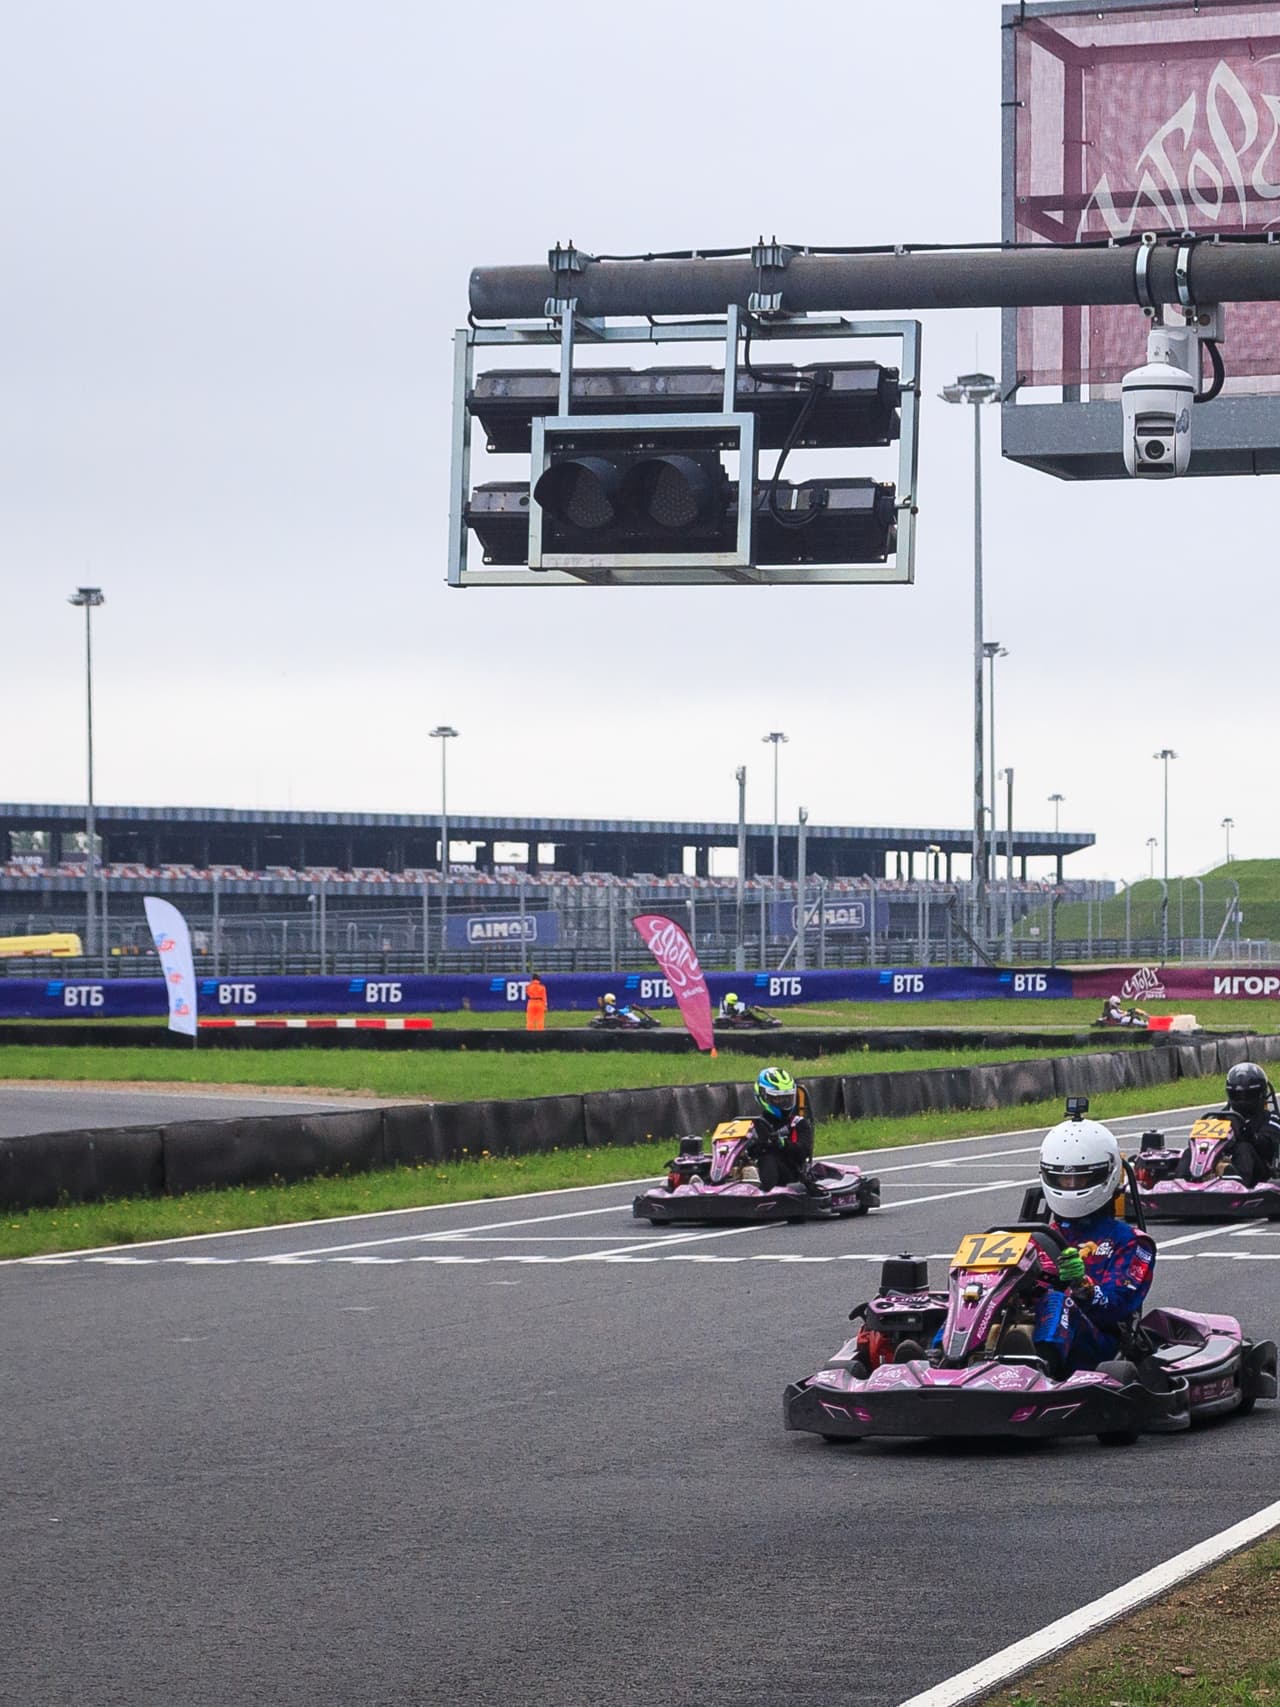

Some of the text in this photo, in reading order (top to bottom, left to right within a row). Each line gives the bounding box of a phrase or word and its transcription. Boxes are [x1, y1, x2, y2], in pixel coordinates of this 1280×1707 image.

[507, 981, 528, 1000] ВТ
[770, 977, 802, 996] ВТБ
[893, 974, 924, 993] ВТБ
[1014, 974, 1047, 991] ВТБ
[64, 985, 104, 1007] ВТБ
[218, 984, 256, 1004] ВТБ
[366, 983, 402, 1002] ВТБ
[1192, 1121, 1227, 1136] 24
[966, 1236, 1017, 1265] 14
